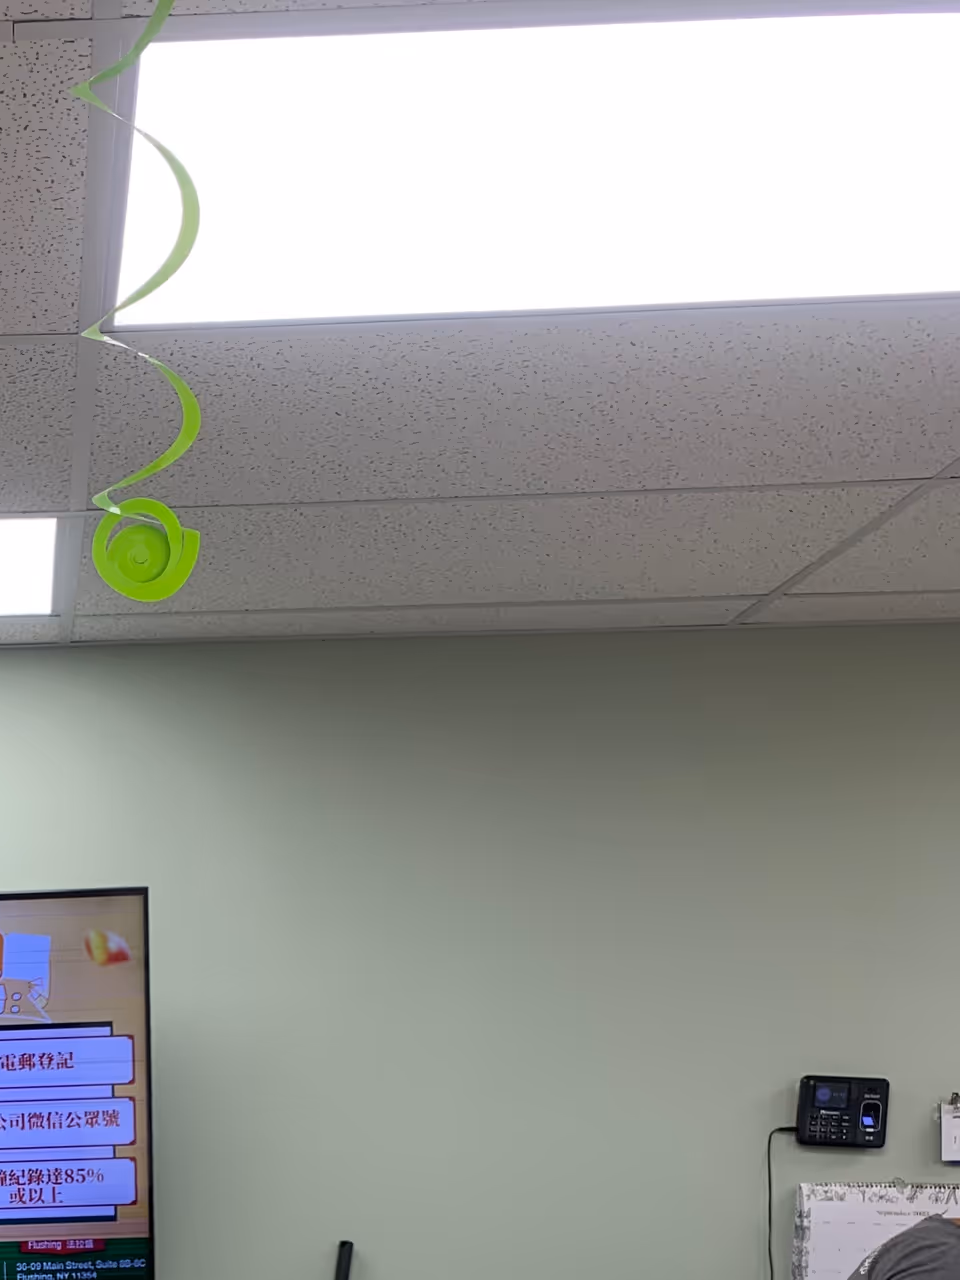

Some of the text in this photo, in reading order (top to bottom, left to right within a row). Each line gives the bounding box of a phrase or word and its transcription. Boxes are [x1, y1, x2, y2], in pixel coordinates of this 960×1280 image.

[0, 1052, 75, 1071] 電郵登記
[9, 1187, 64, 1204] 或以上
[28, 1240, 62, 1250] Flushing
[43, 1262, 65, 1271] Main
[57, 1272, 70, 1280] NY
